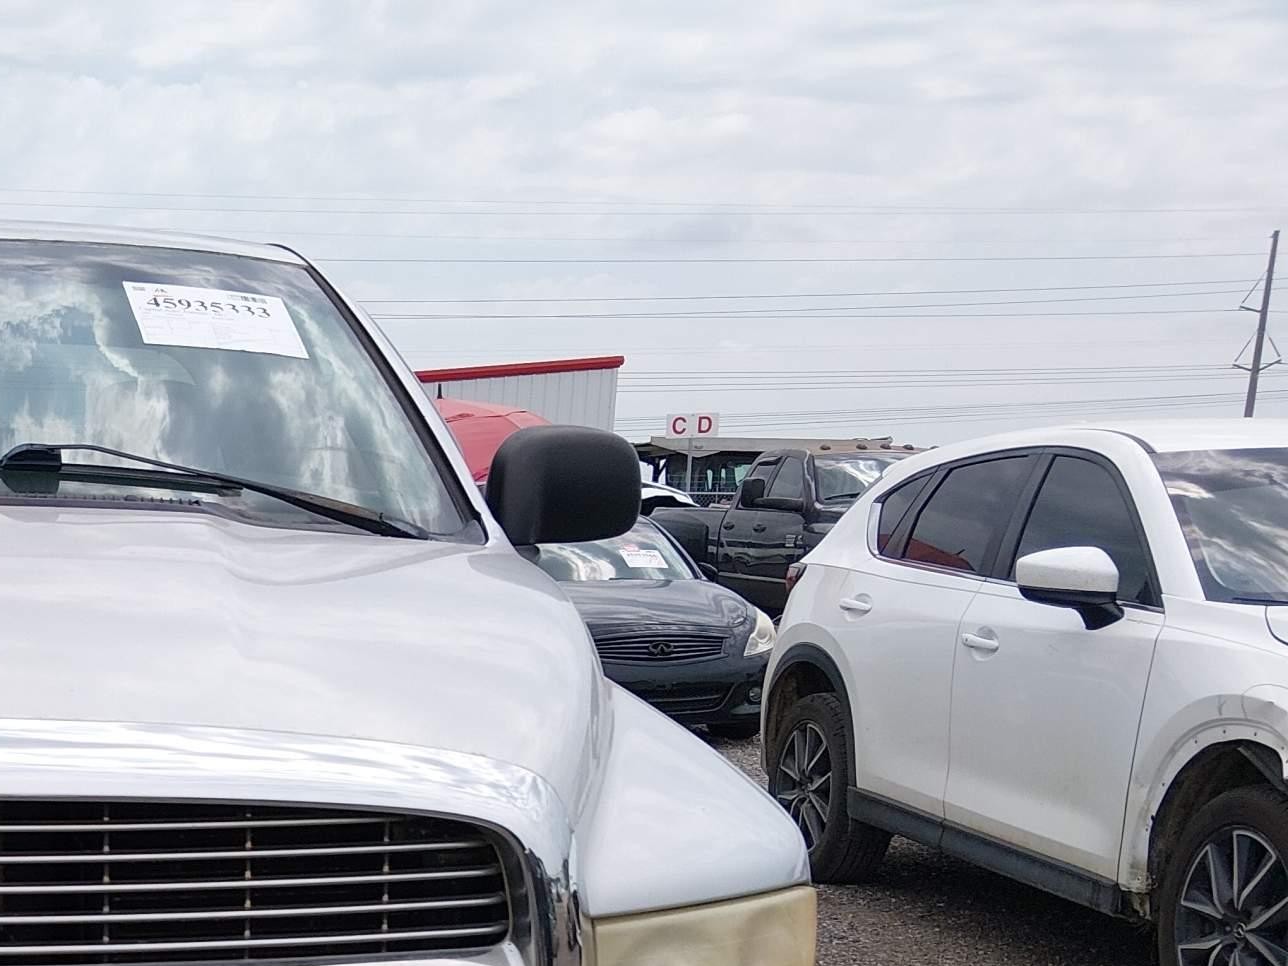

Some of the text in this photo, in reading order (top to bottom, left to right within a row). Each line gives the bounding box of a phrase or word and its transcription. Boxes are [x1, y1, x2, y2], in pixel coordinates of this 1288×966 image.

[146, 296, 271, 319] 45935333
[672, 416, 712, 435] C D
